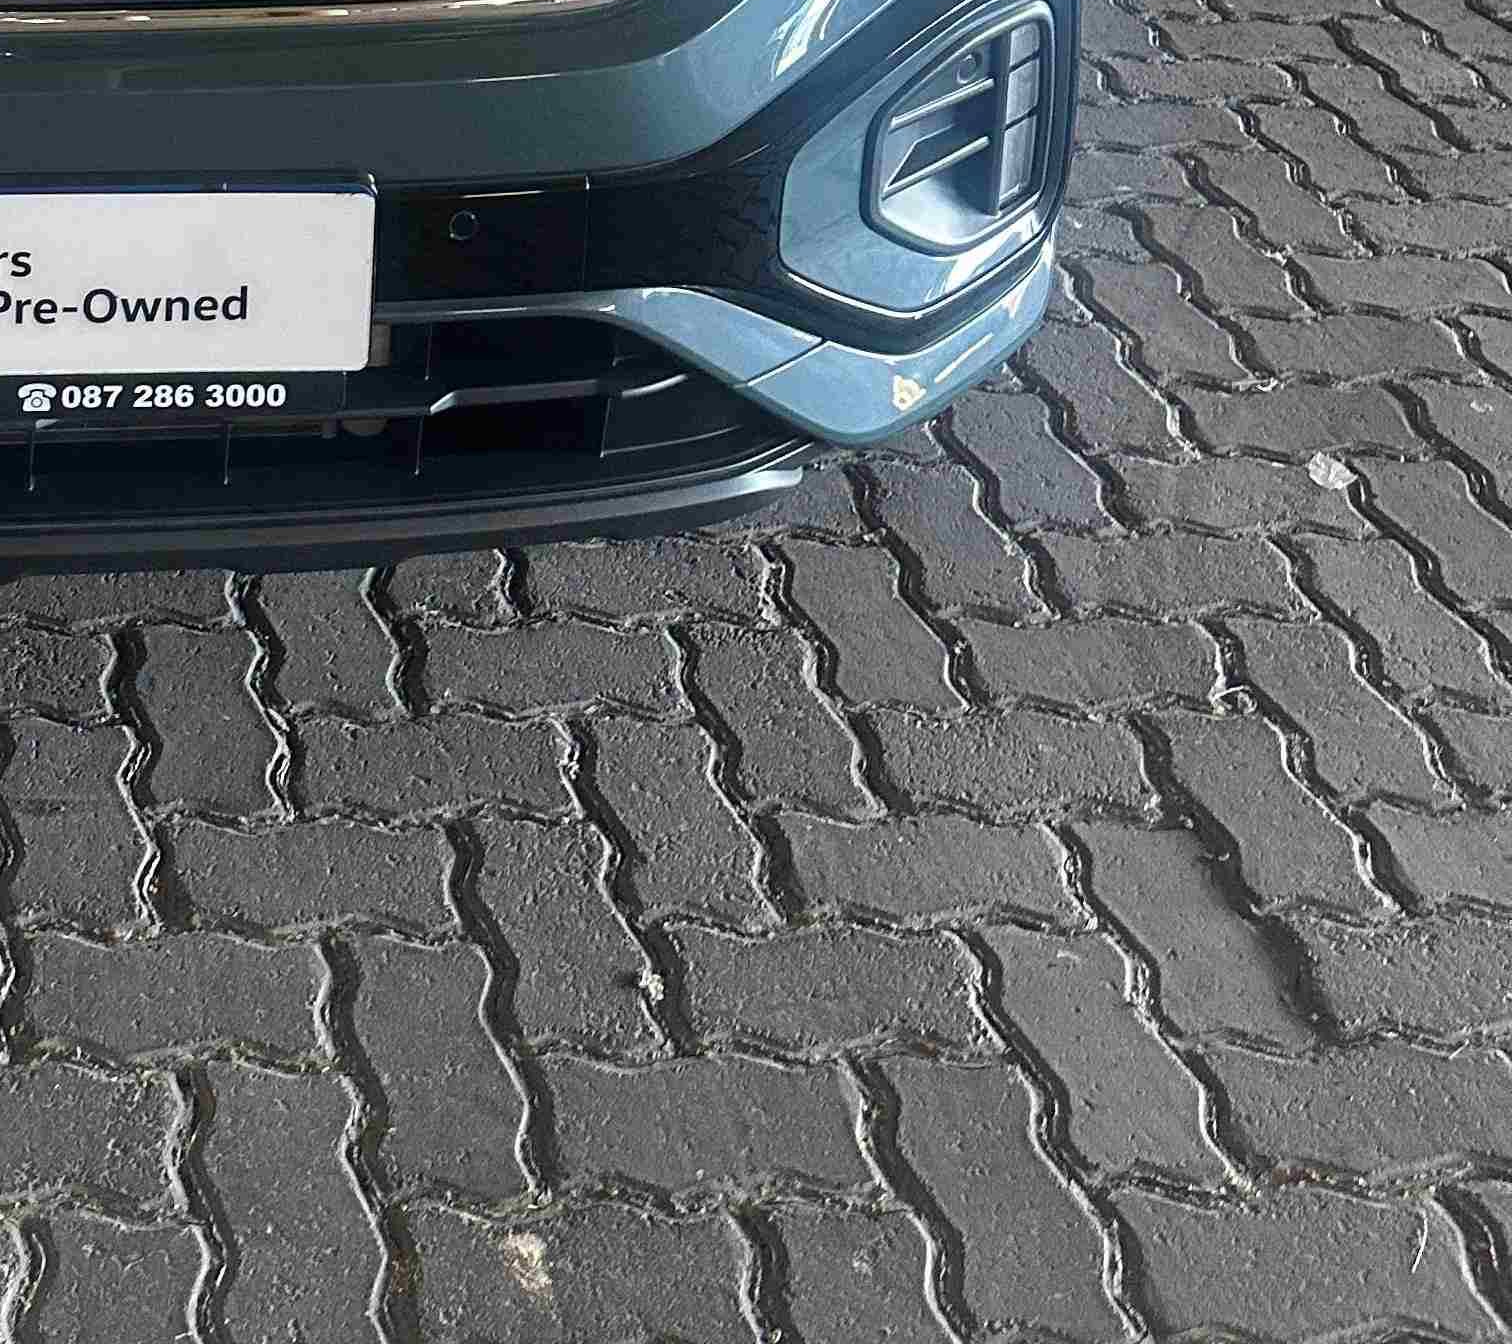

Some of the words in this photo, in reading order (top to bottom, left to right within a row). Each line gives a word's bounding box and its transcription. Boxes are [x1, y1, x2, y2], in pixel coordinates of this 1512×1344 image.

[60, 384, 124, 410] 087
[131, 383, 195, 409] 286
[204, 382, 287, 408] 3000
